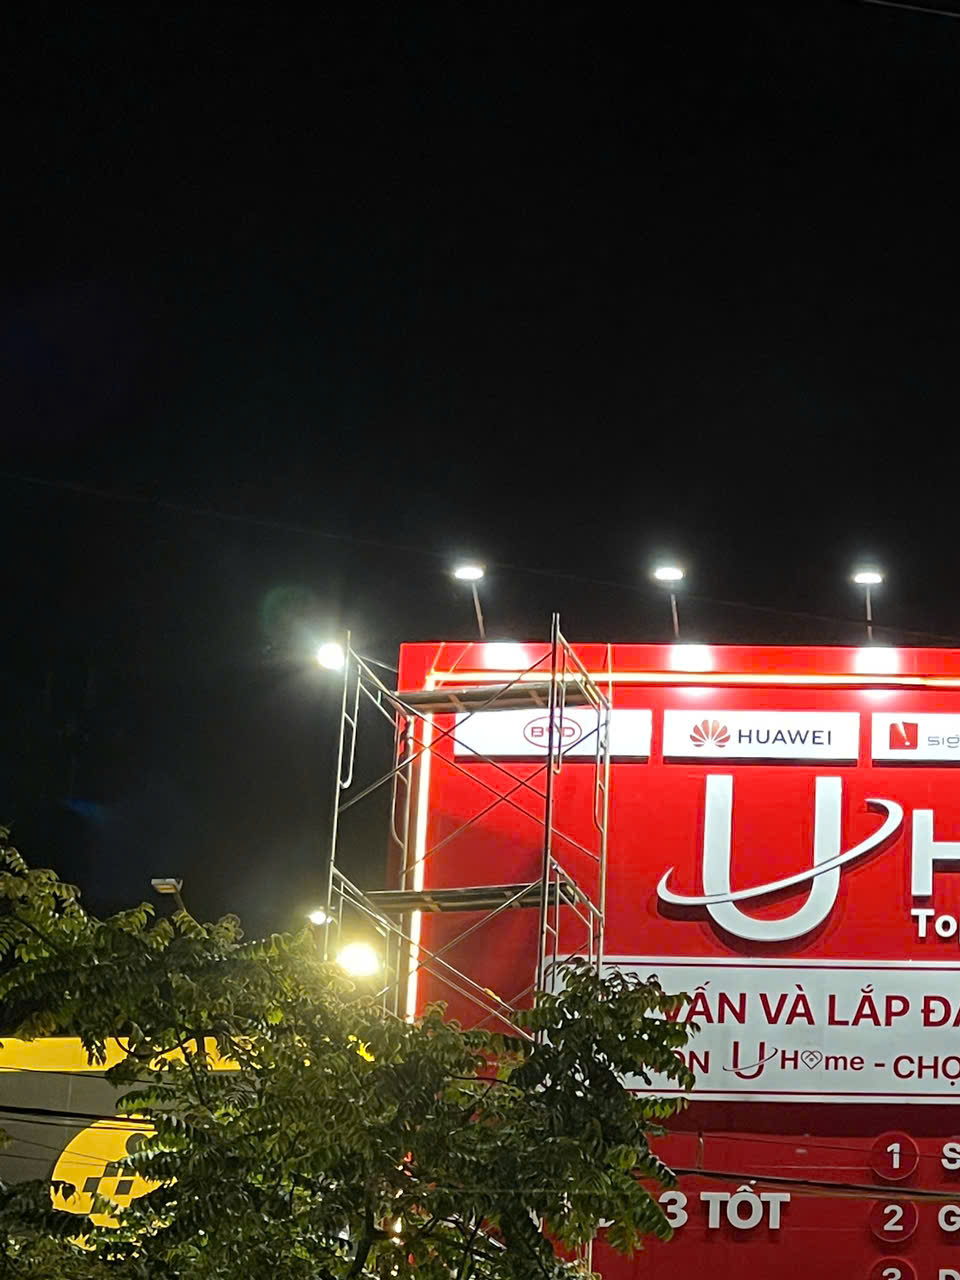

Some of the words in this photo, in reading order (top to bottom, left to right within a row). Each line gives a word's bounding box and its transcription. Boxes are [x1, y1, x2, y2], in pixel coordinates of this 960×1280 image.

[531, 727, 575, 739] BD
[738, 729, 831, 745] HUAWEI
[759, 984, 816, 1025] VÀ
[828, 984, 910, 1027] LẮP
[886, 1143, 901, 1169] 1
[700, 1180, 791, 1229] TỐT
[883, 1205, 904, 1232] 2
